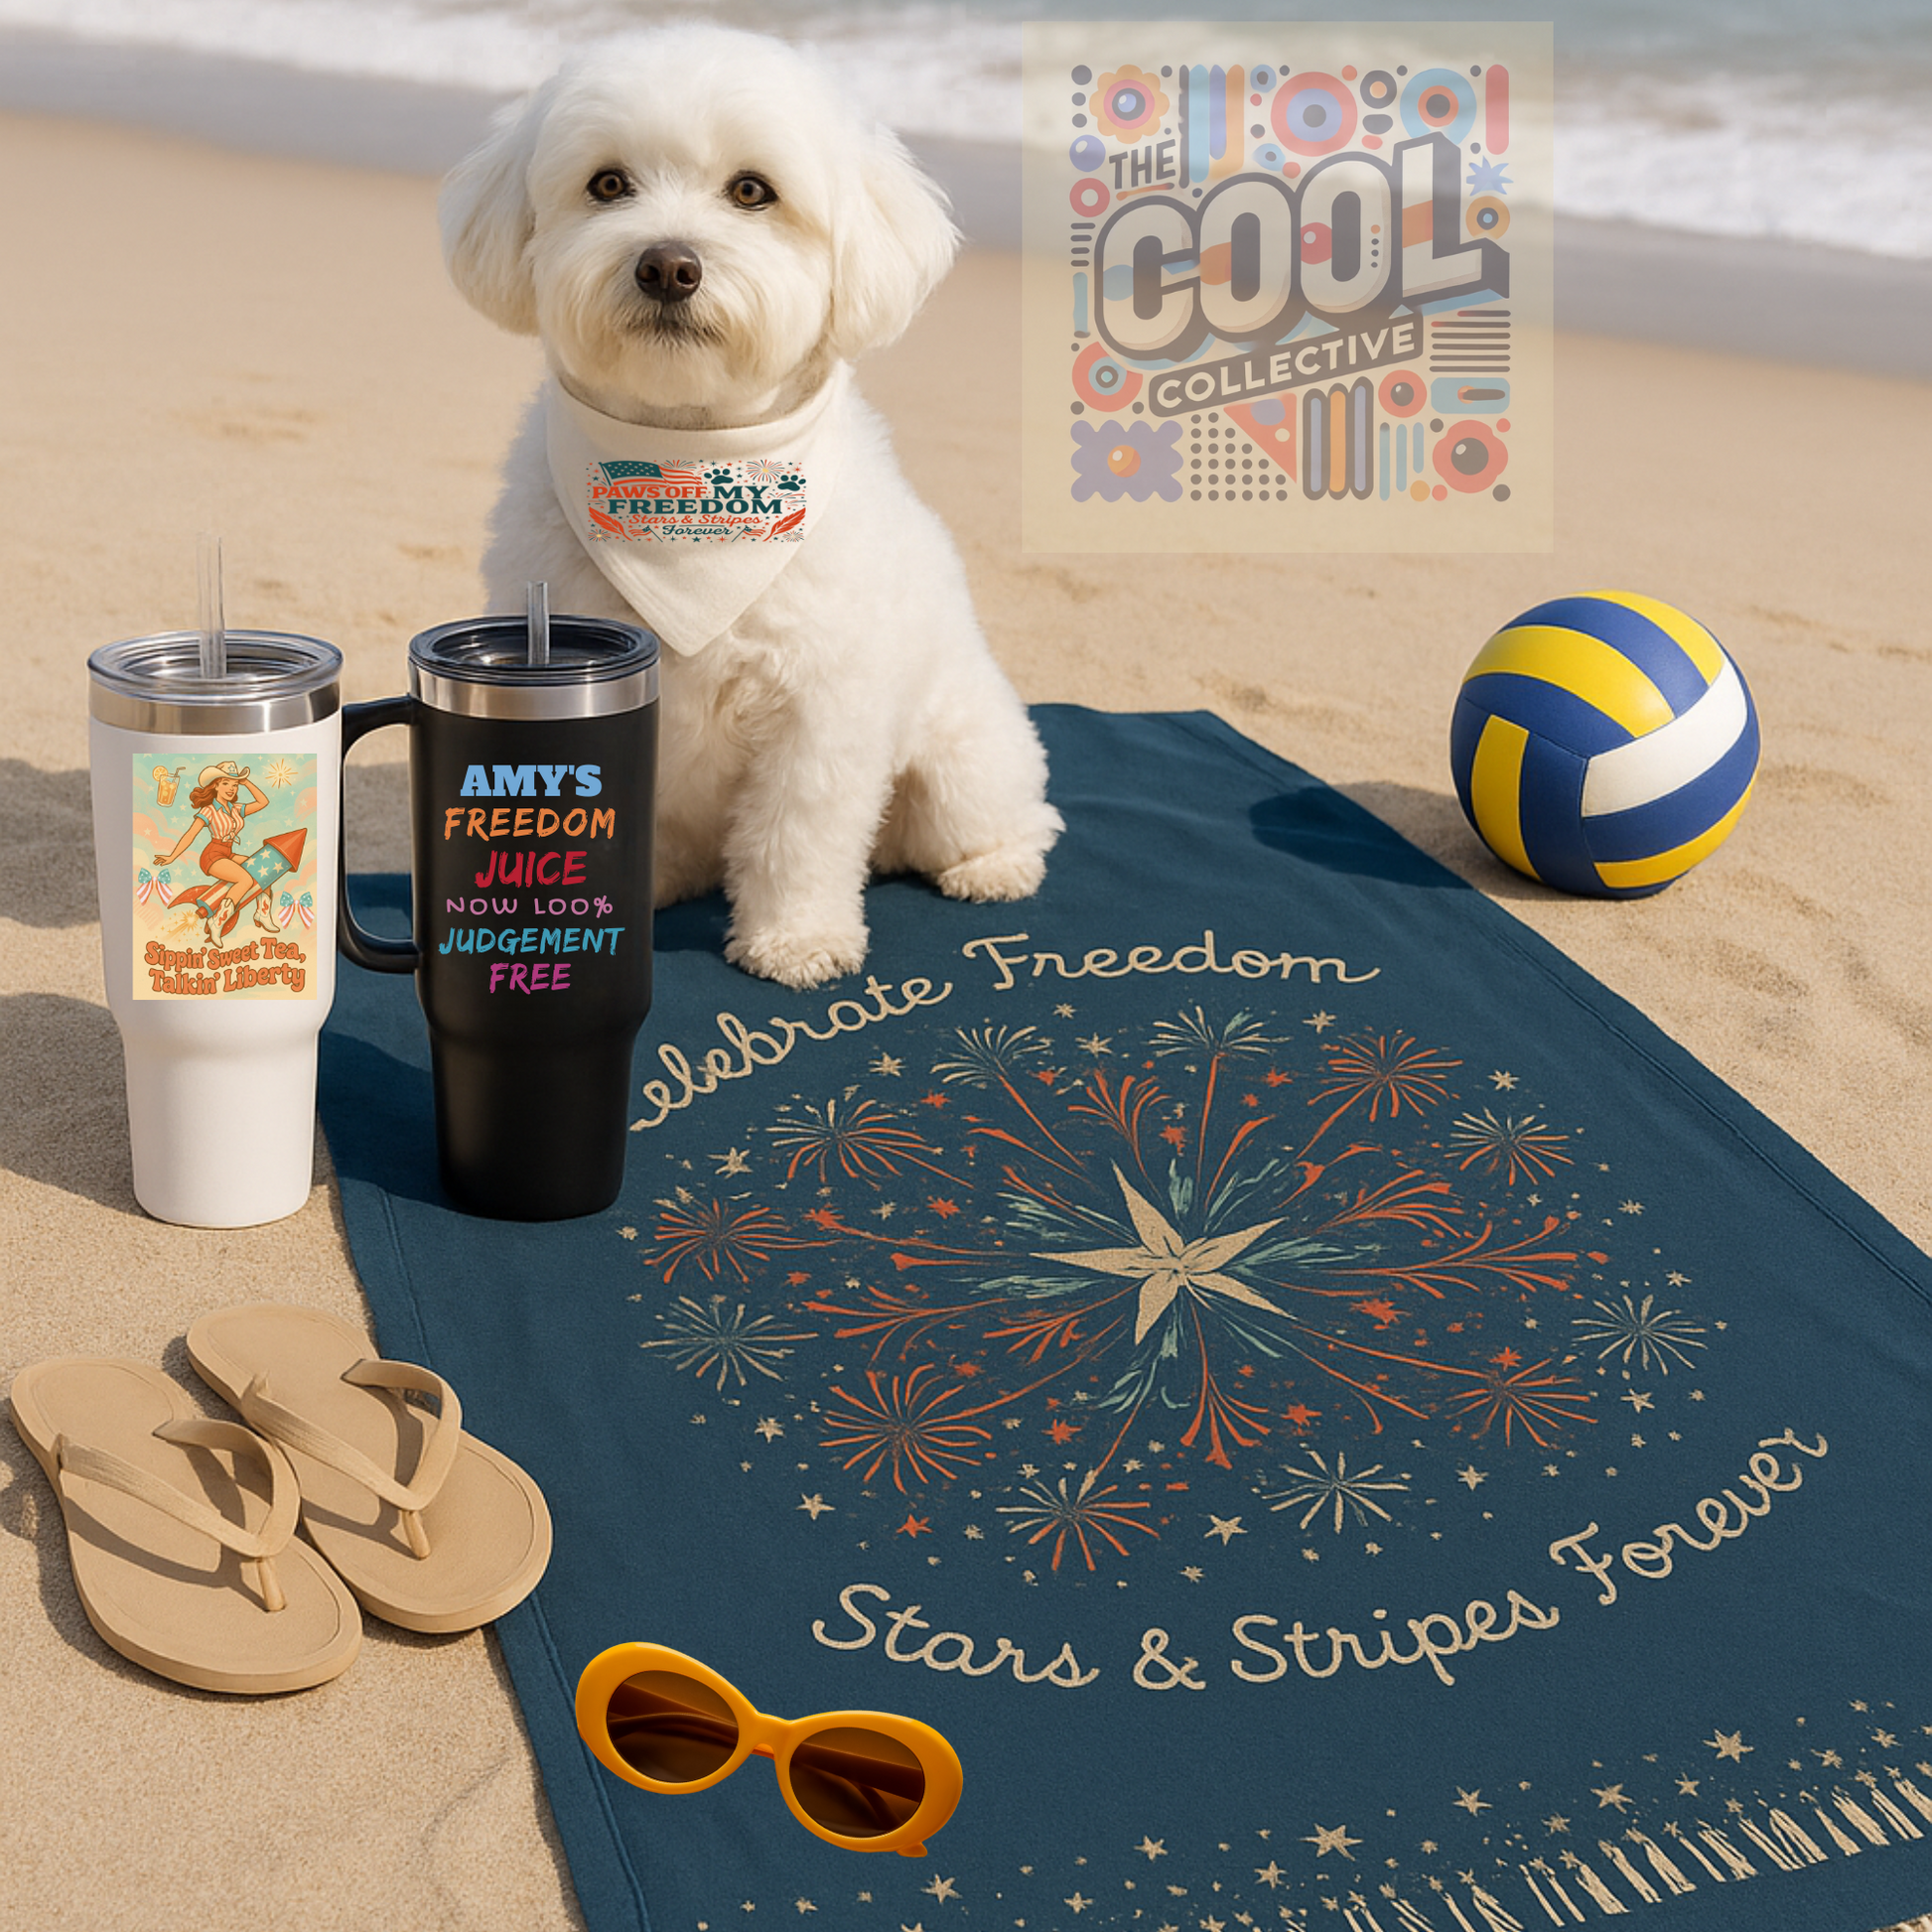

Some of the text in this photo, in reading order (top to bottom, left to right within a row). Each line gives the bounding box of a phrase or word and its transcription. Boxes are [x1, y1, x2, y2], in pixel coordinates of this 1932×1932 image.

[592, 485, 769, 499] PAWS OFF MY
[608, 499, 782, 514] FREEDOM
[628, 514, 762, 527] Stars & Stripes
[662, 525, 733, 536] Forever
[460, 764, 603, 797] AMY'S
[444, 807, 616, 841] FREEDOM
[475, 850, 588, 888] JUICE
[446, 897, 518, 915] NOW
[144, 937, 307, 971] Sippin' Sweet Tea,
[438, 927, 625, 956] JUDGEMENT
[149, 963, 306, 995] Talkin' Liberty
[489, 962, 572, 995] FREE
[628, 929, 1381, 1132] elebrate Freedom
[812, 1427, 1829, 1691] Stars & Stripes Forever
